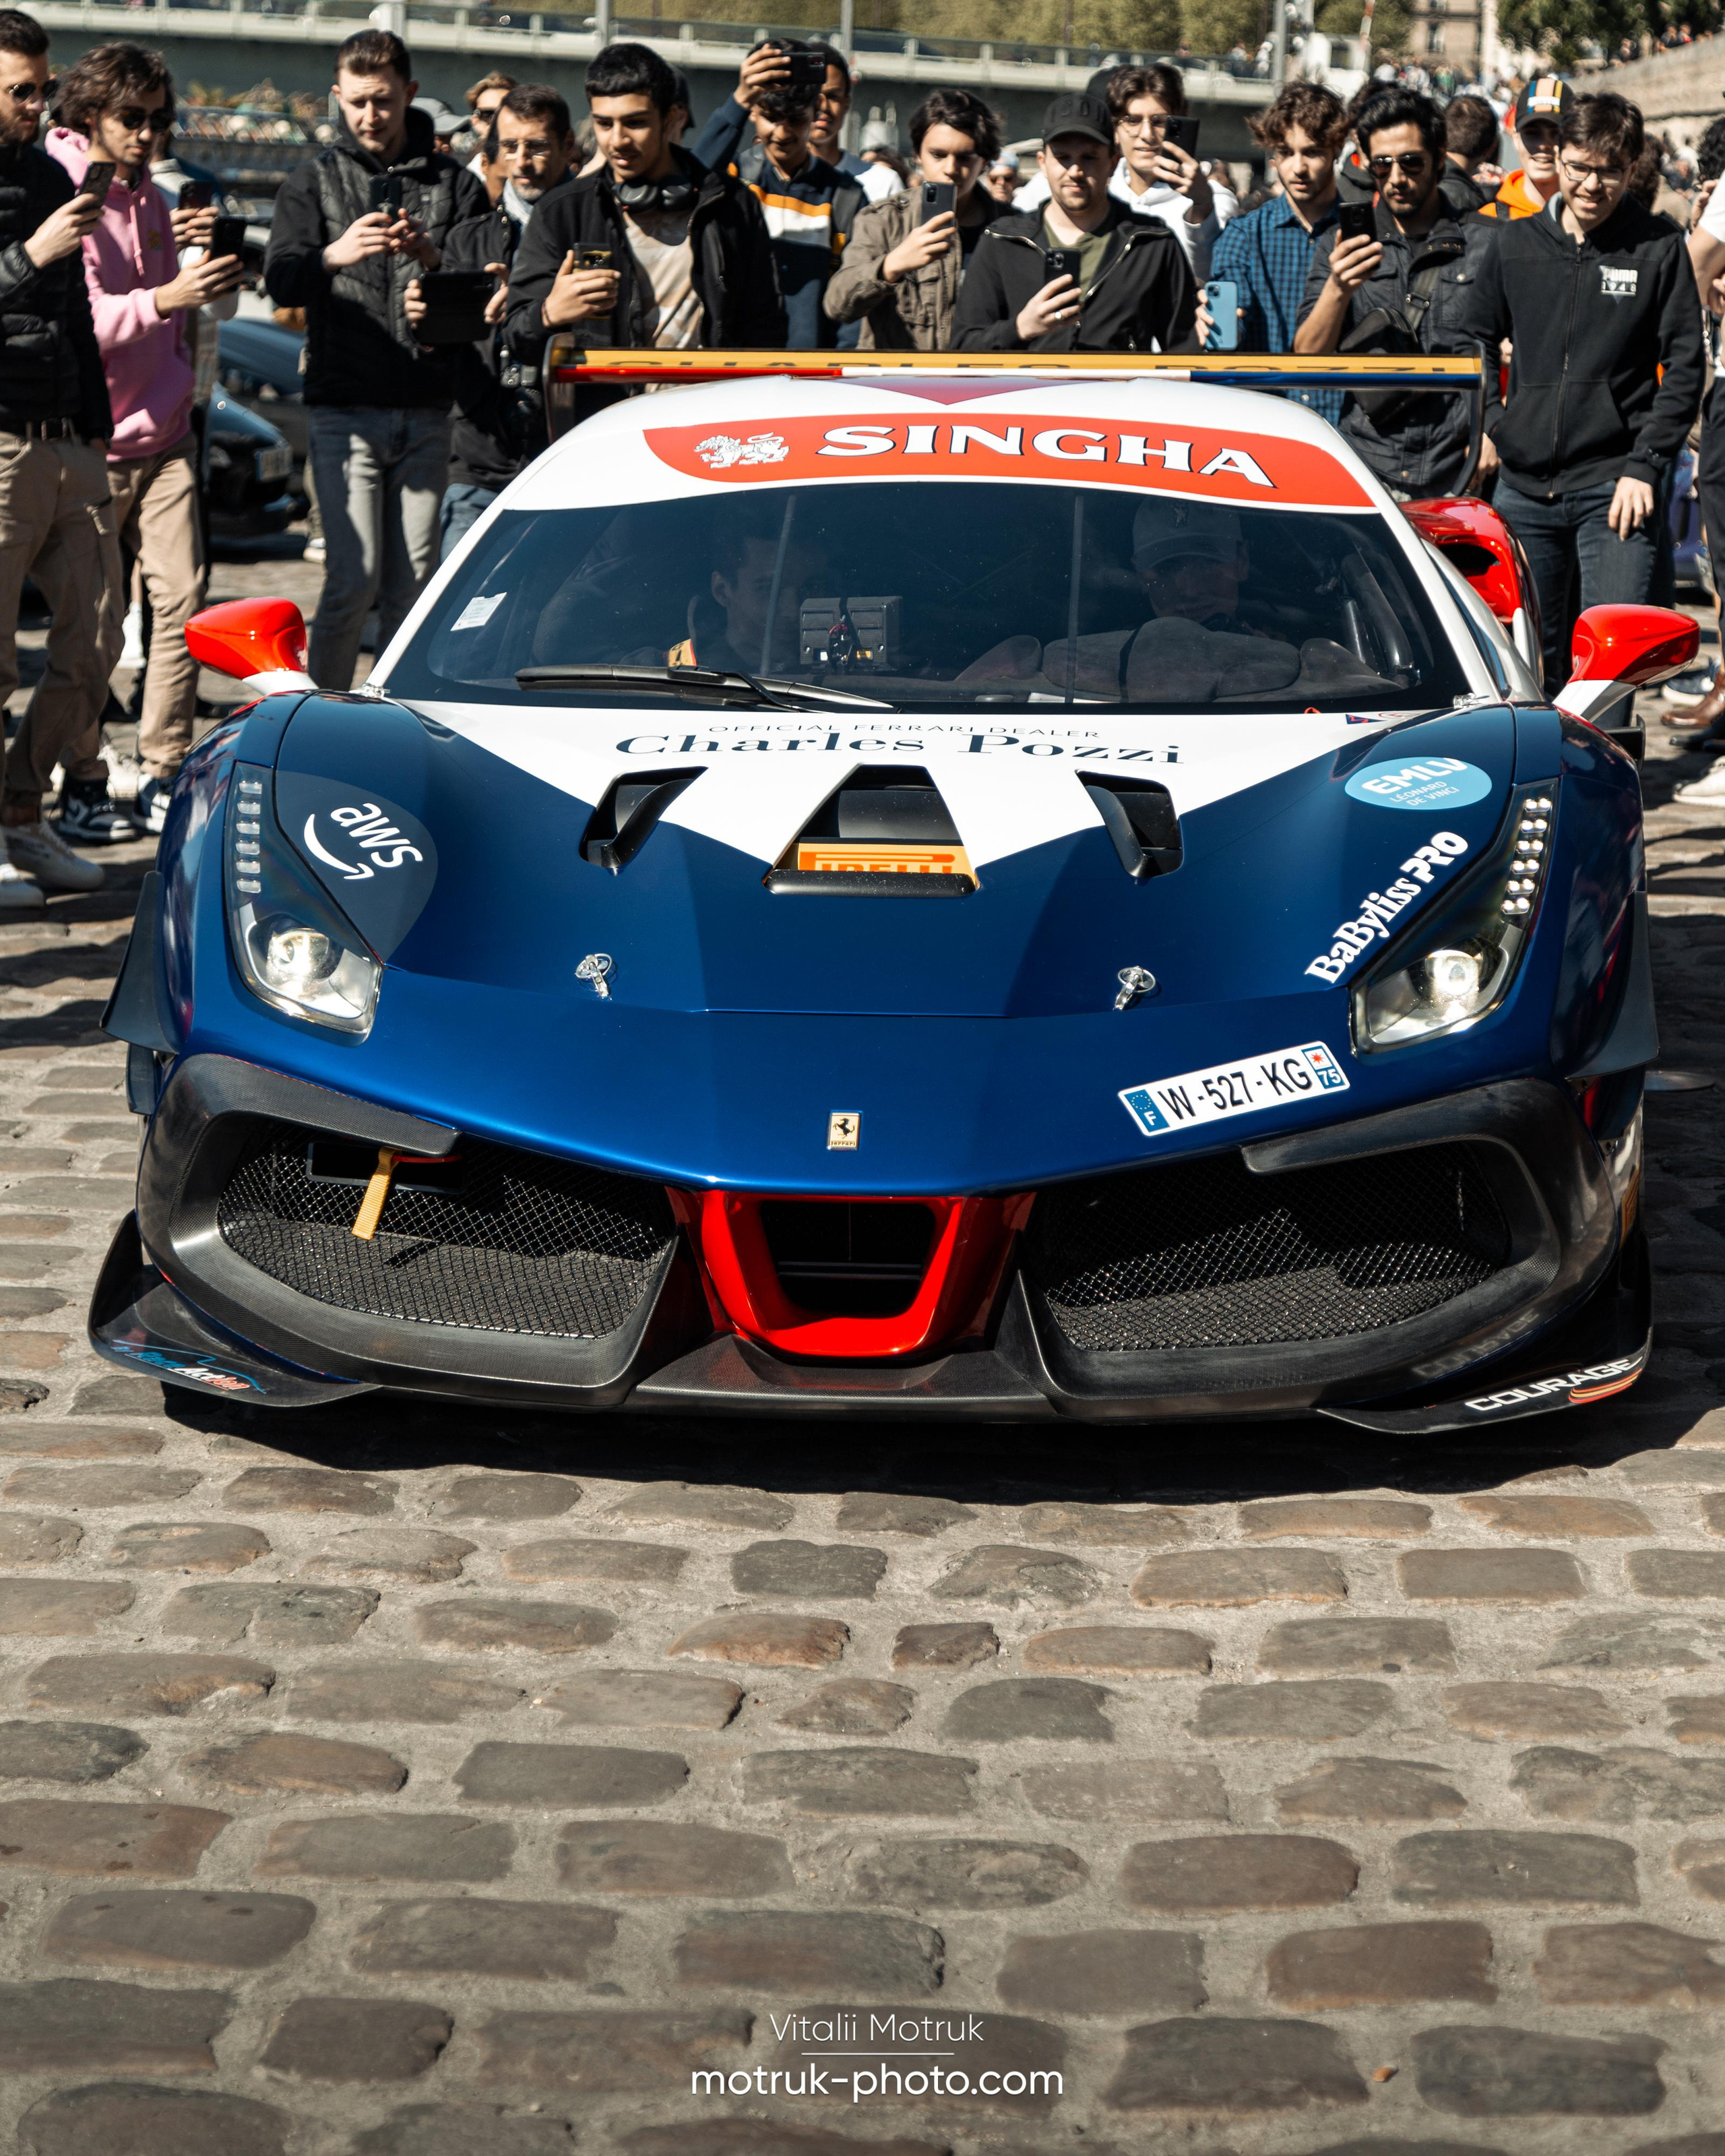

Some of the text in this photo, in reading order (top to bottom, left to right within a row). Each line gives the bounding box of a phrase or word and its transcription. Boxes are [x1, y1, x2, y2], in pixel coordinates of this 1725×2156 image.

[815, 425, 1278, 488] SINGHA
[616, 732, 1185, 764] Charles Pozzi
[989, 727, 1100, 738] DEALER
[1362, 757, 1468, 794] EMLV
[1406, 786, 1460, 806] DE VINCI
[330, 802, 423, 868] aws
[1304, 877, 1422, 984] BaByliss
[1400, 831, 1468, 883] PRO
[1317, 1069, 1342, 1086] 75
[1144, 1110, 1156, 1127] F
[129, 1352, 186, 1368] Race
[174, 1368, 250, 1391] Action
[1465, 1356, 1643, 1411] COURAGE
